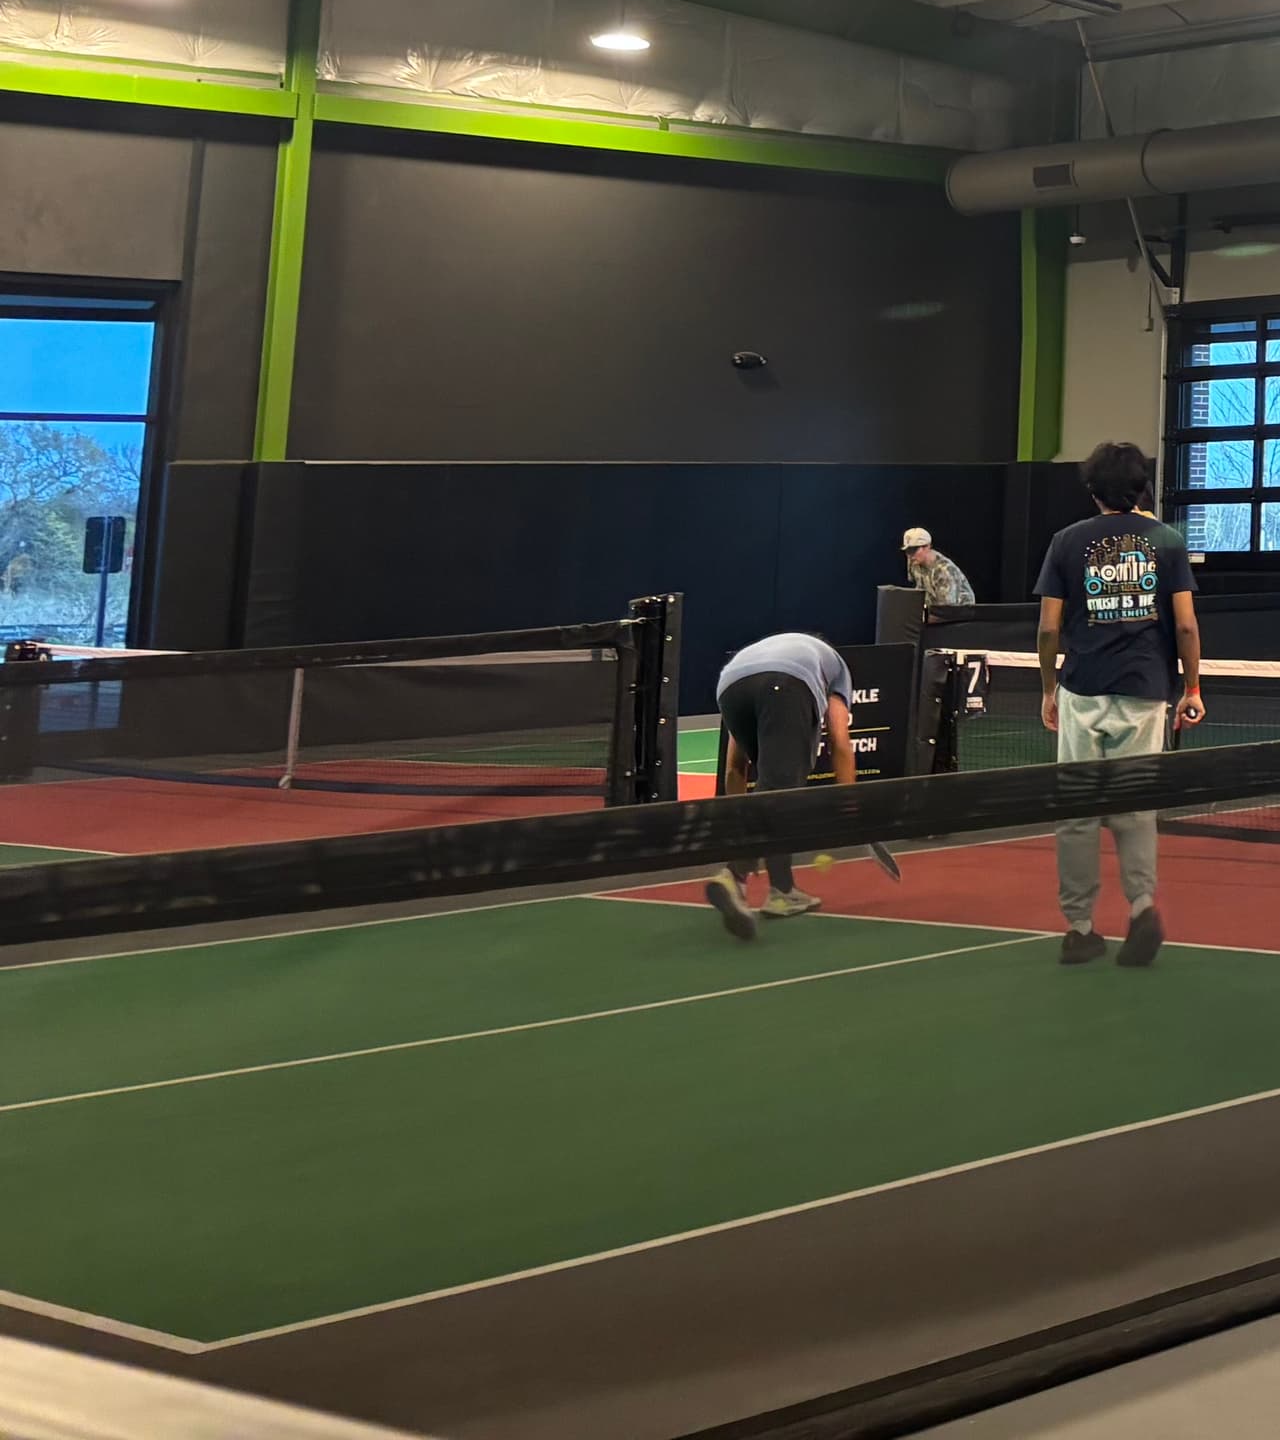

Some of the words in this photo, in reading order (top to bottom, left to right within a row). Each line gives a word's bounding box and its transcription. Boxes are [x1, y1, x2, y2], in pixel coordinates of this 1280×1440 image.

[1122, 595, 1134, 608] IS
[968, 661, 981, 694] 7
[851, 688, 880, 704] KLE
[851, 737, 877, 753] TCH
